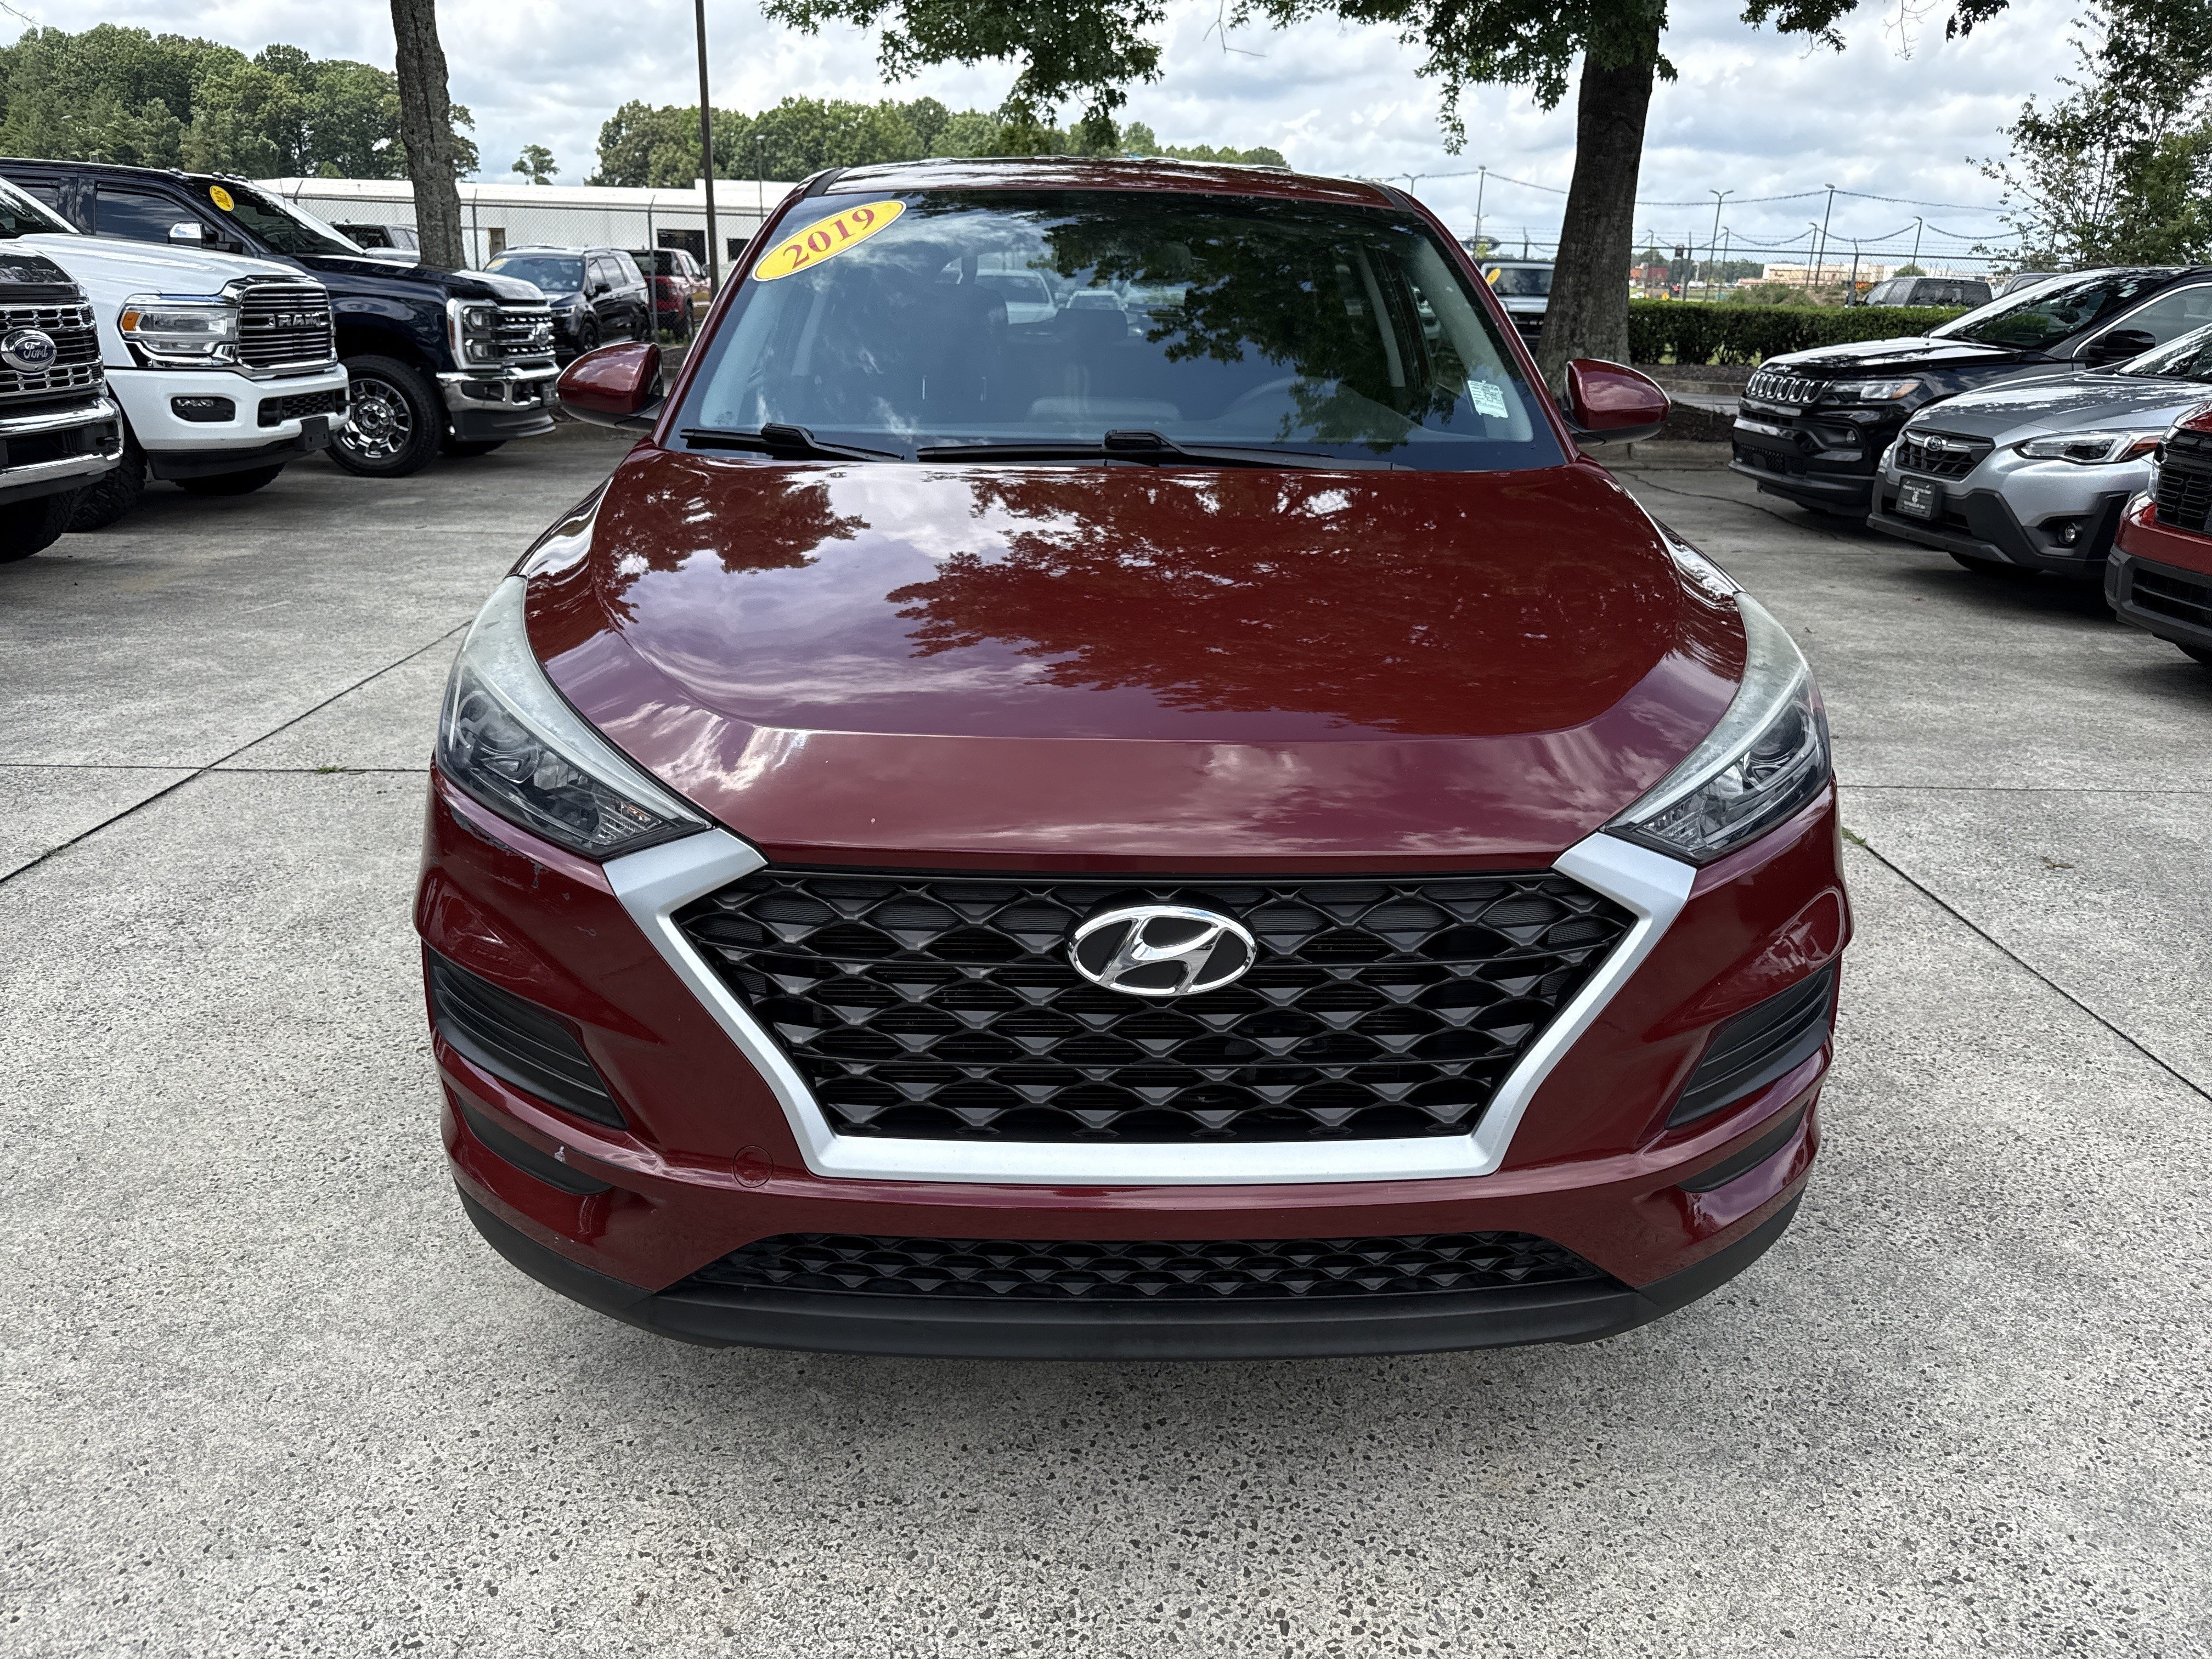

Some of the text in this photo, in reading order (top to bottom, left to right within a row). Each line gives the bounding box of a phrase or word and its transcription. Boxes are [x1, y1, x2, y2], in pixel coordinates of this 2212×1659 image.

[783, 208, 875, 269] 2019
[278, 314, 320, 327] RAM
[23, 341, 48, 359] Ford
